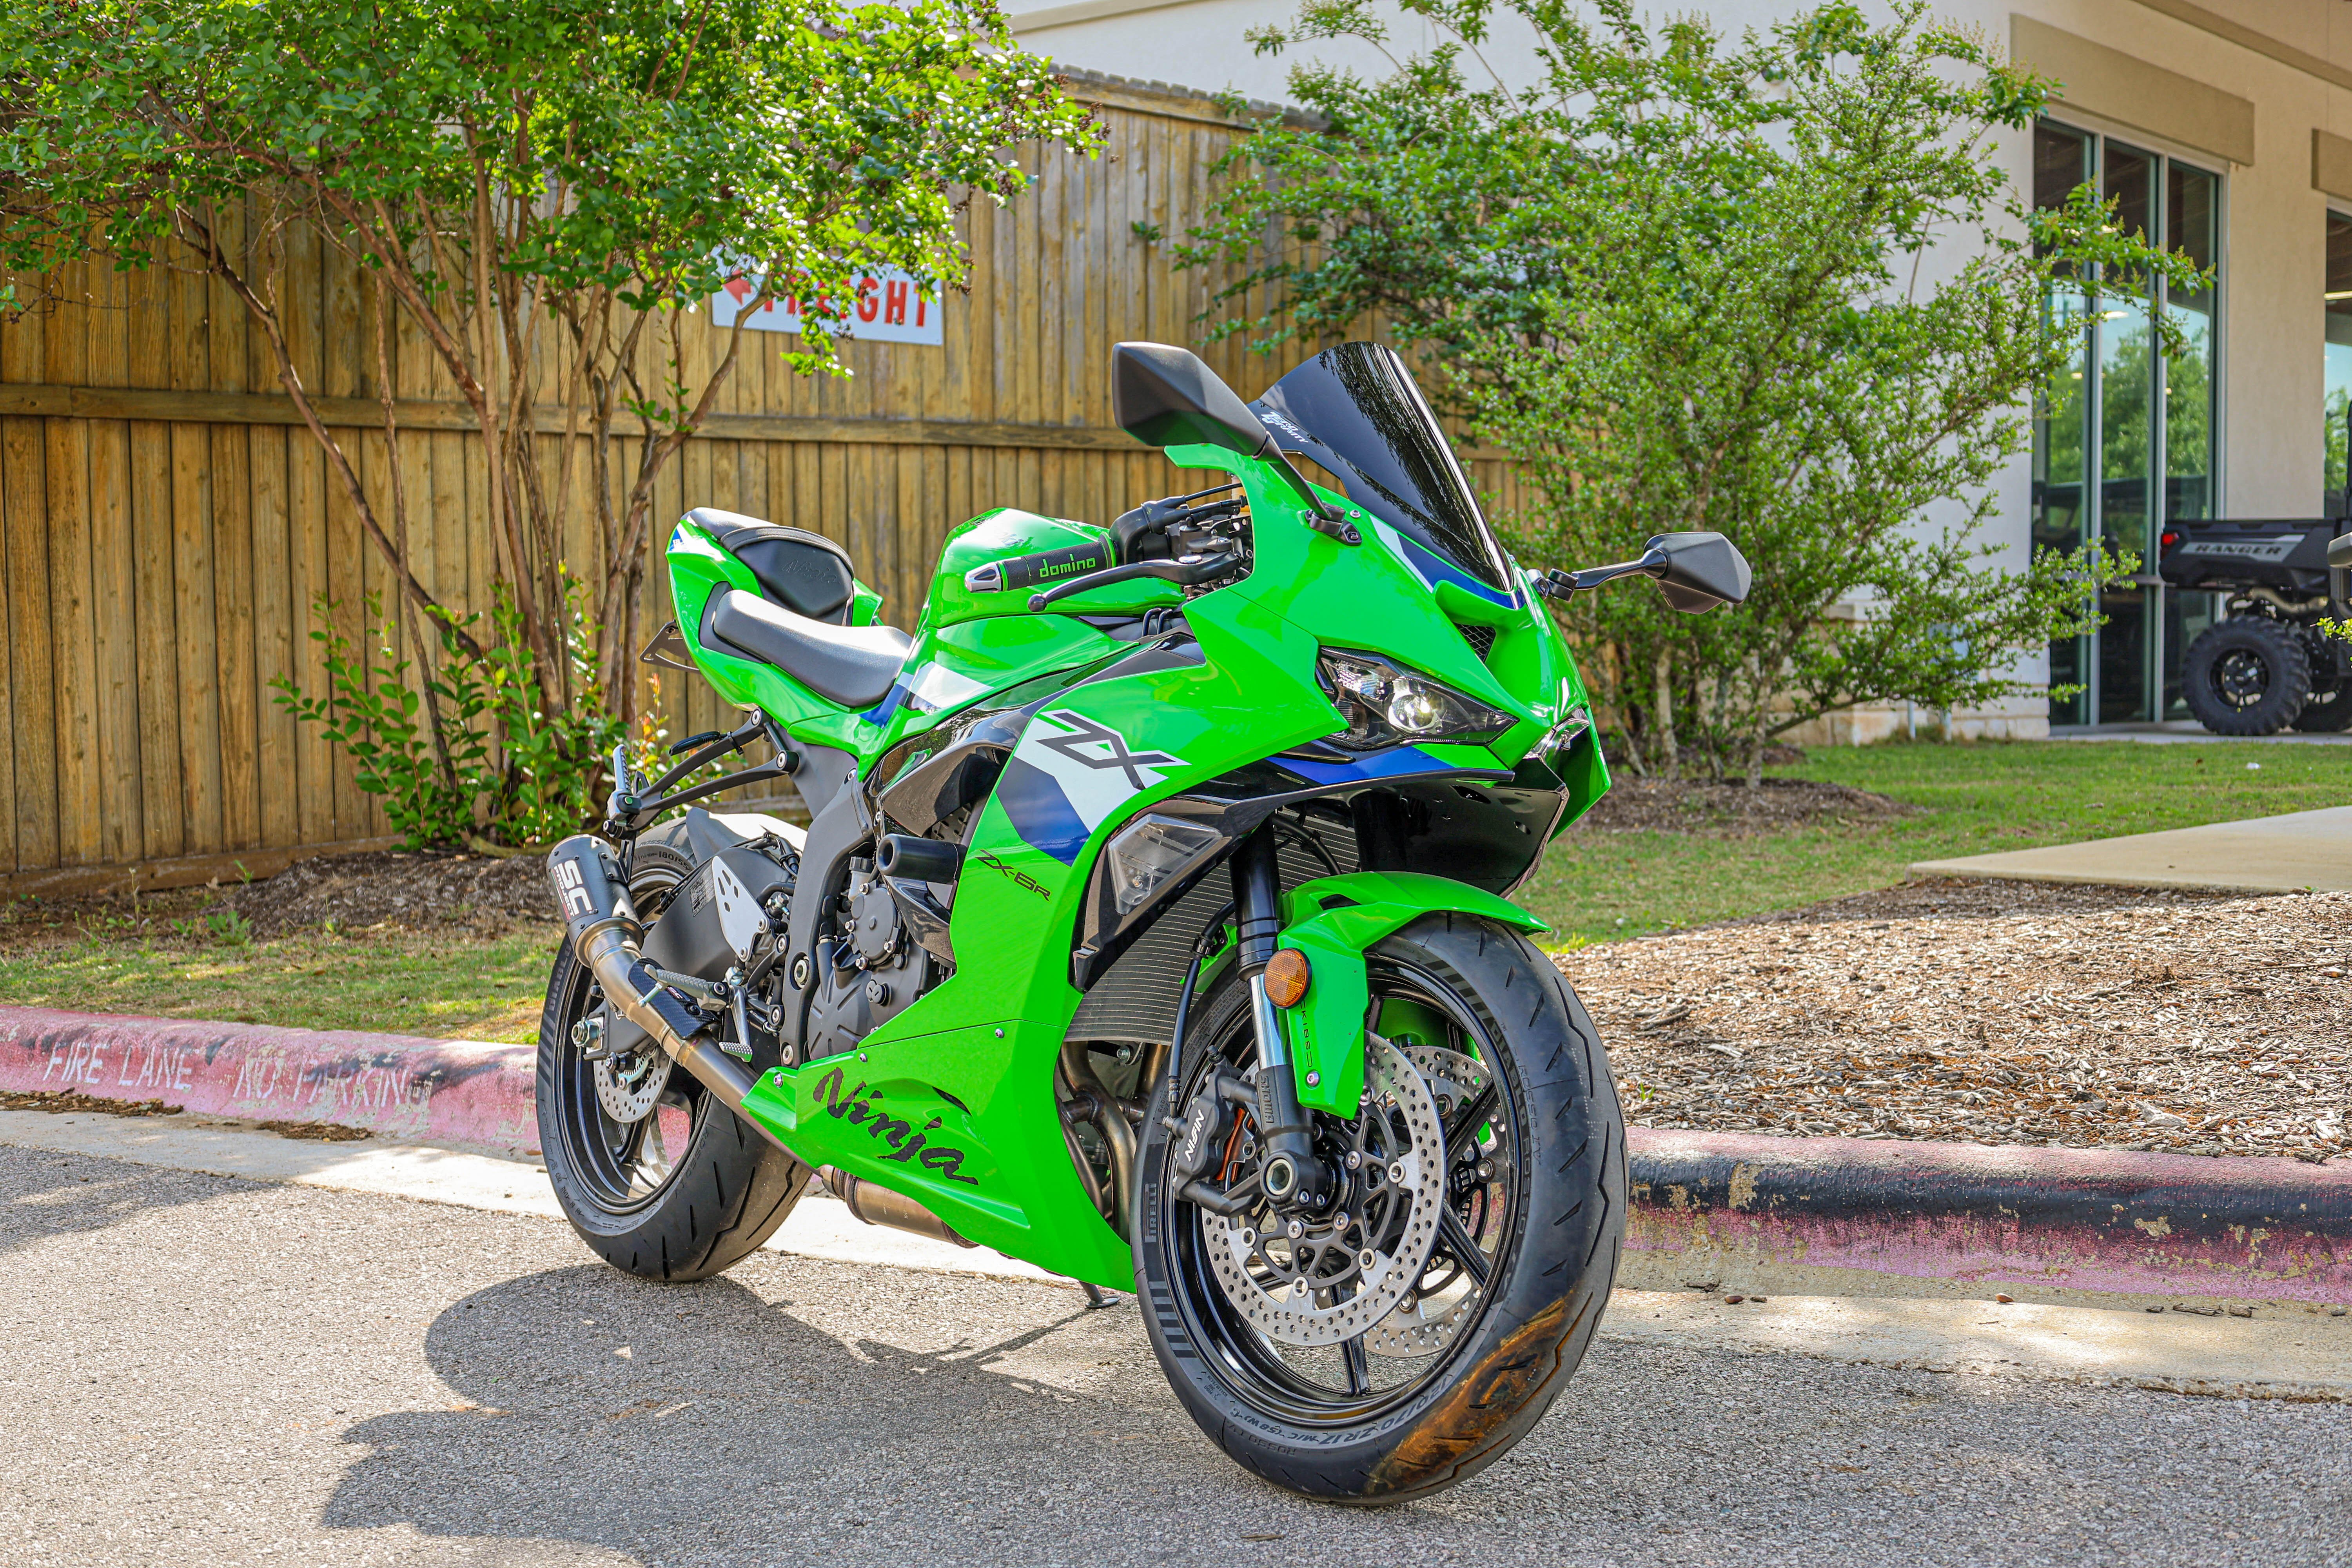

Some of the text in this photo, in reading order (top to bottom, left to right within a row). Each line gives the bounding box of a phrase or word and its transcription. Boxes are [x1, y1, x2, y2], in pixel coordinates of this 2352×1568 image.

[1261, 412, 1298, 431] ZERO
[1261, 417, 1308, 443] GRAVITY
[1039, 554, 1096, 578] domino
[2196, 544, 2282, 554] RANGER
[1034, 712, 1177, 789] ZX
[554, 866, 574, 917] PROJECT
[557, 860, 592, 915] SC
[975, 849, 1051, 902] ZX-6R
[549, 944, 572, 1011] DIABLO
[43, 1042, 110, 1083] FIRE
[118, 1045, 199, 1091] LANE
[1261, 1075, 1275, 1123] SHOWA
[813, 1067, 979, 1185] Ninja
[1185, 1109, 1204, 1162] NISSIN
[1490, 1022, 1530, 1234] DIABLO ROSSO
[1143, 1182, 1157, 1243] PIRELLI
[1244, 1415, 1282, 1436] (58W)
[1381, 1376, 1448, 1430] 120/70
[1249, 1435, 1297, 1457] ROSSO
